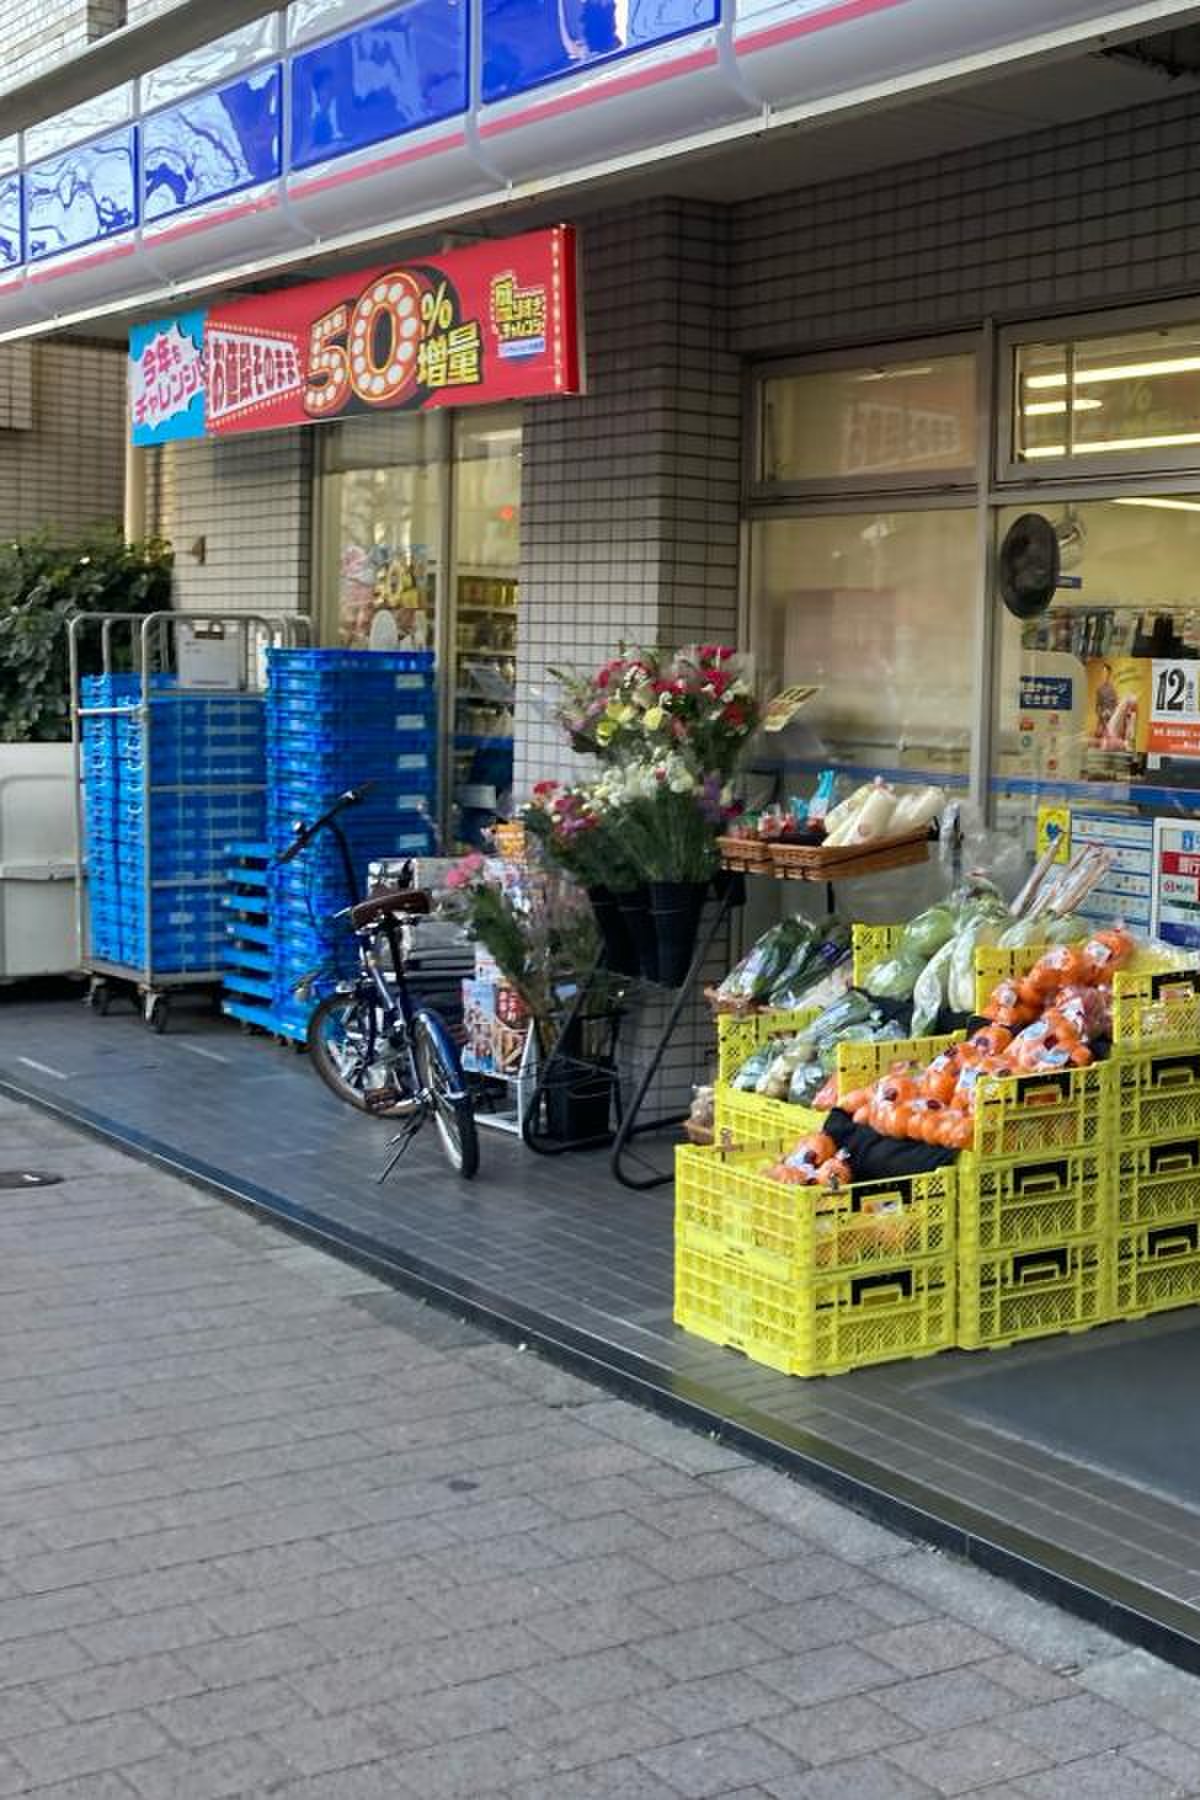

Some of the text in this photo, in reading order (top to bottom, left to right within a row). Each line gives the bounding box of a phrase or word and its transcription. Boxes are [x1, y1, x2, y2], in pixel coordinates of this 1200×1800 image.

[143, 336, 182, 387] 今年も
[212, 337, 294, 413] お値段そのまま
[416, 320, 480, 387] 増量
[1156, 669, 1184, 710] 12
